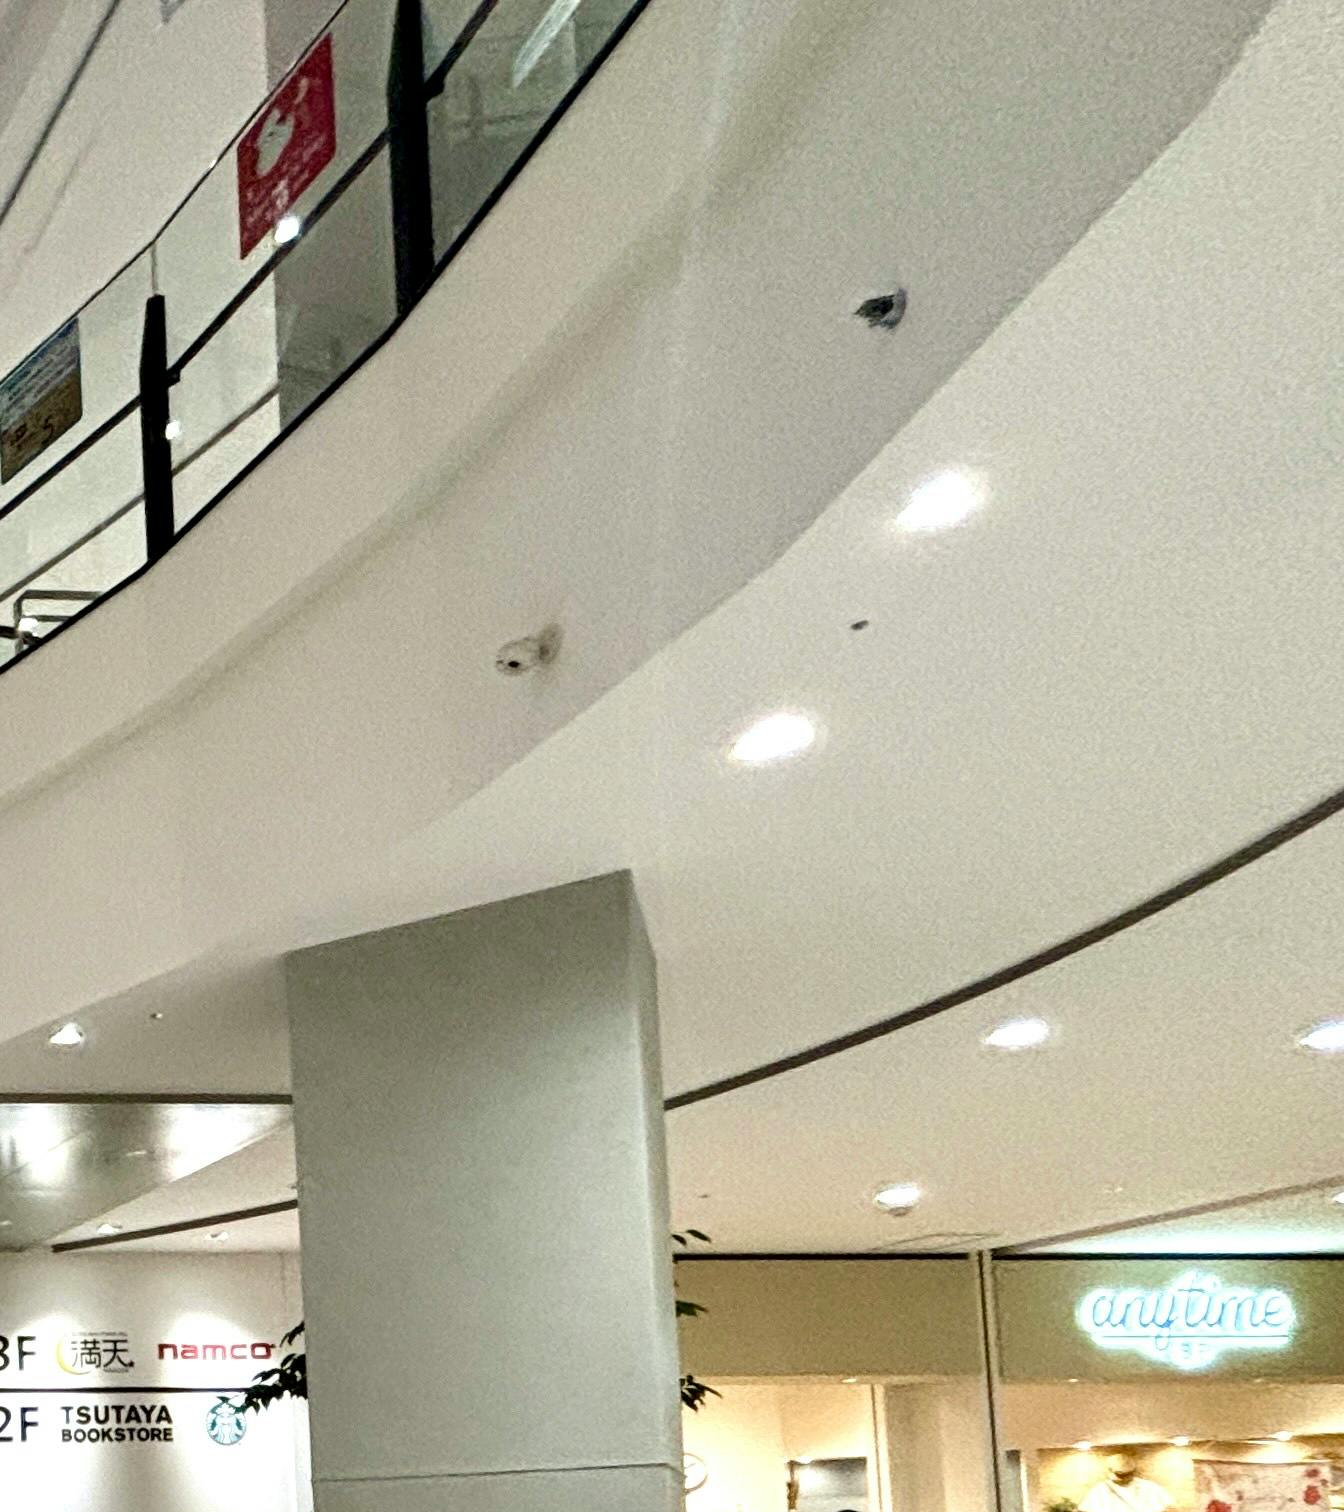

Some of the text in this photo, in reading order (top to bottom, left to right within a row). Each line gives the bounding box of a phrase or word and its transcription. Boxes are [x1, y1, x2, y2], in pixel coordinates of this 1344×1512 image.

[1092, 1272, 1286, 1351] anytime
[70, 1338, 132, 1369] 満天
[157, 1342, 272, 1360] namco
[61, 1404, 173, 1425] TSUTAYA
[61, 1426, 174, 1444] BOOKSTORE
